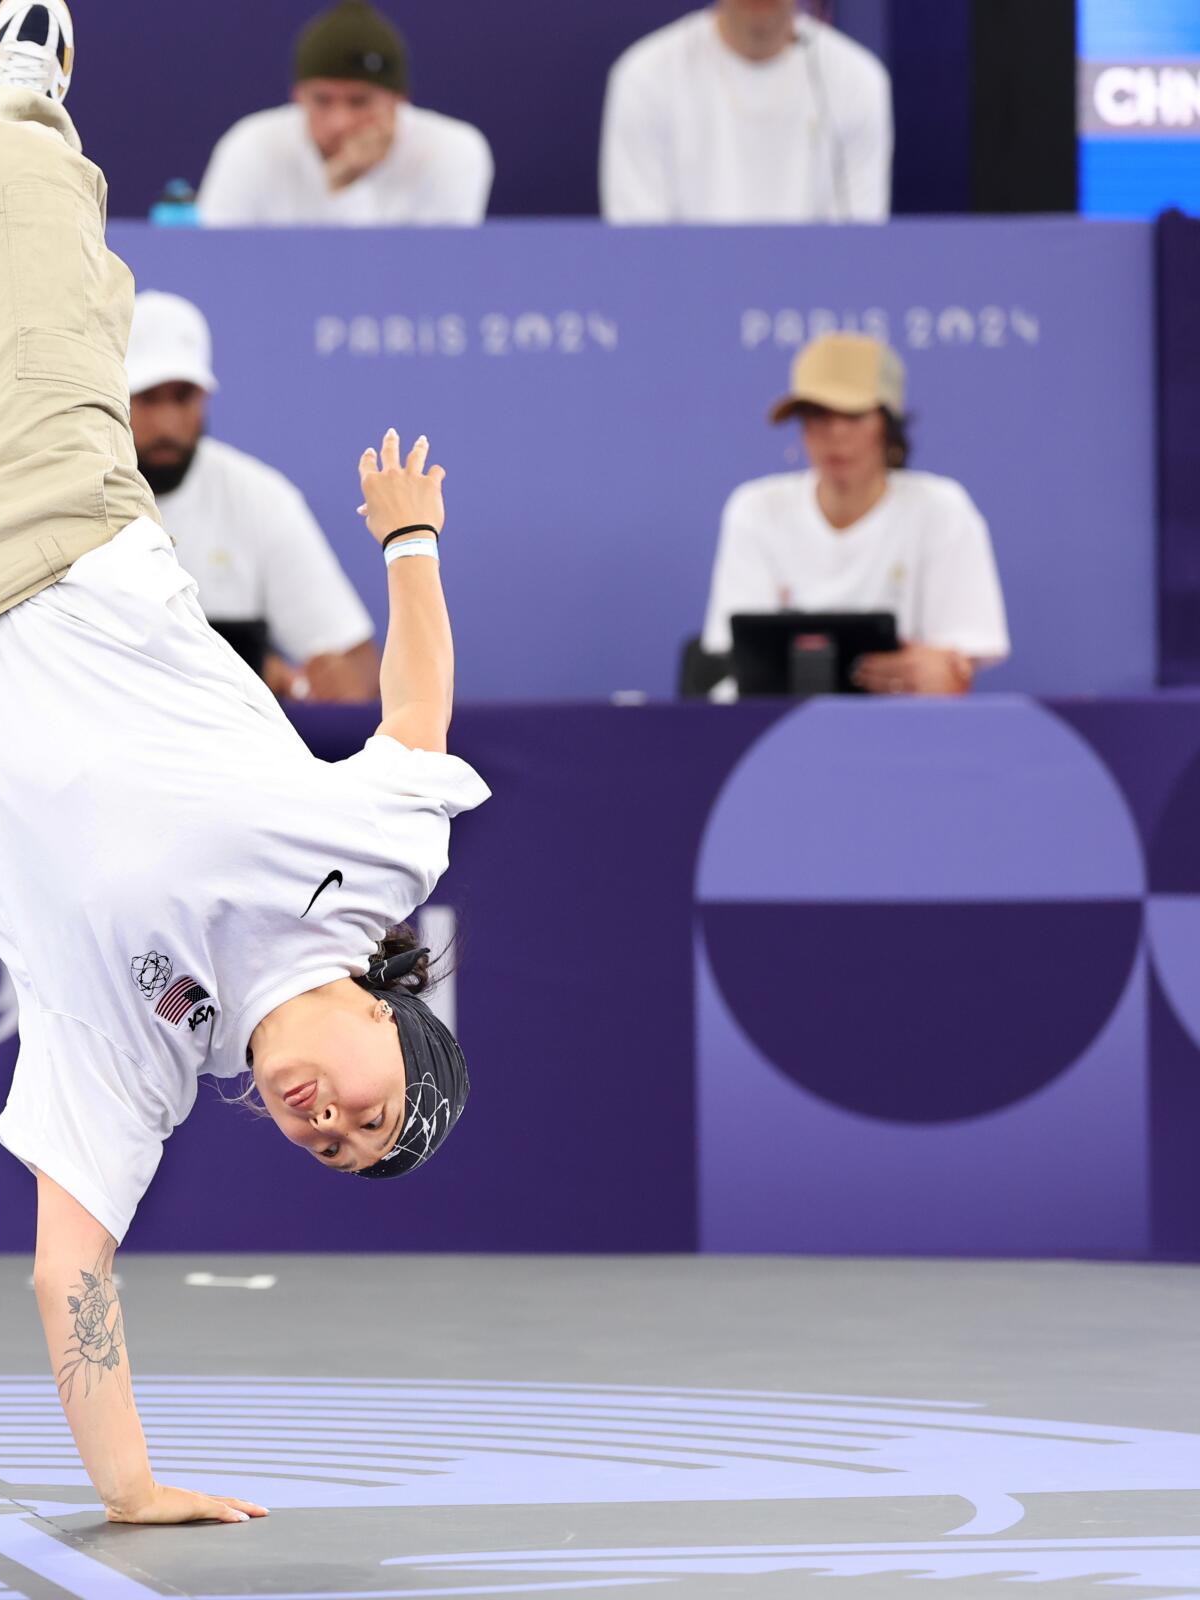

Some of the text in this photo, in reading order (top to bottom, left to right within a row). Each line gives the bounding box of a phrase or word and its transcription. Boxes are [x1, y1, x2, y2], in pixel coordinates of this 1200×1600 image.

[315, 309, 619, 356] PARIS 2024
[904, 304, 1039, 348] 2024
[187, 1005, 216, 1032] USA
